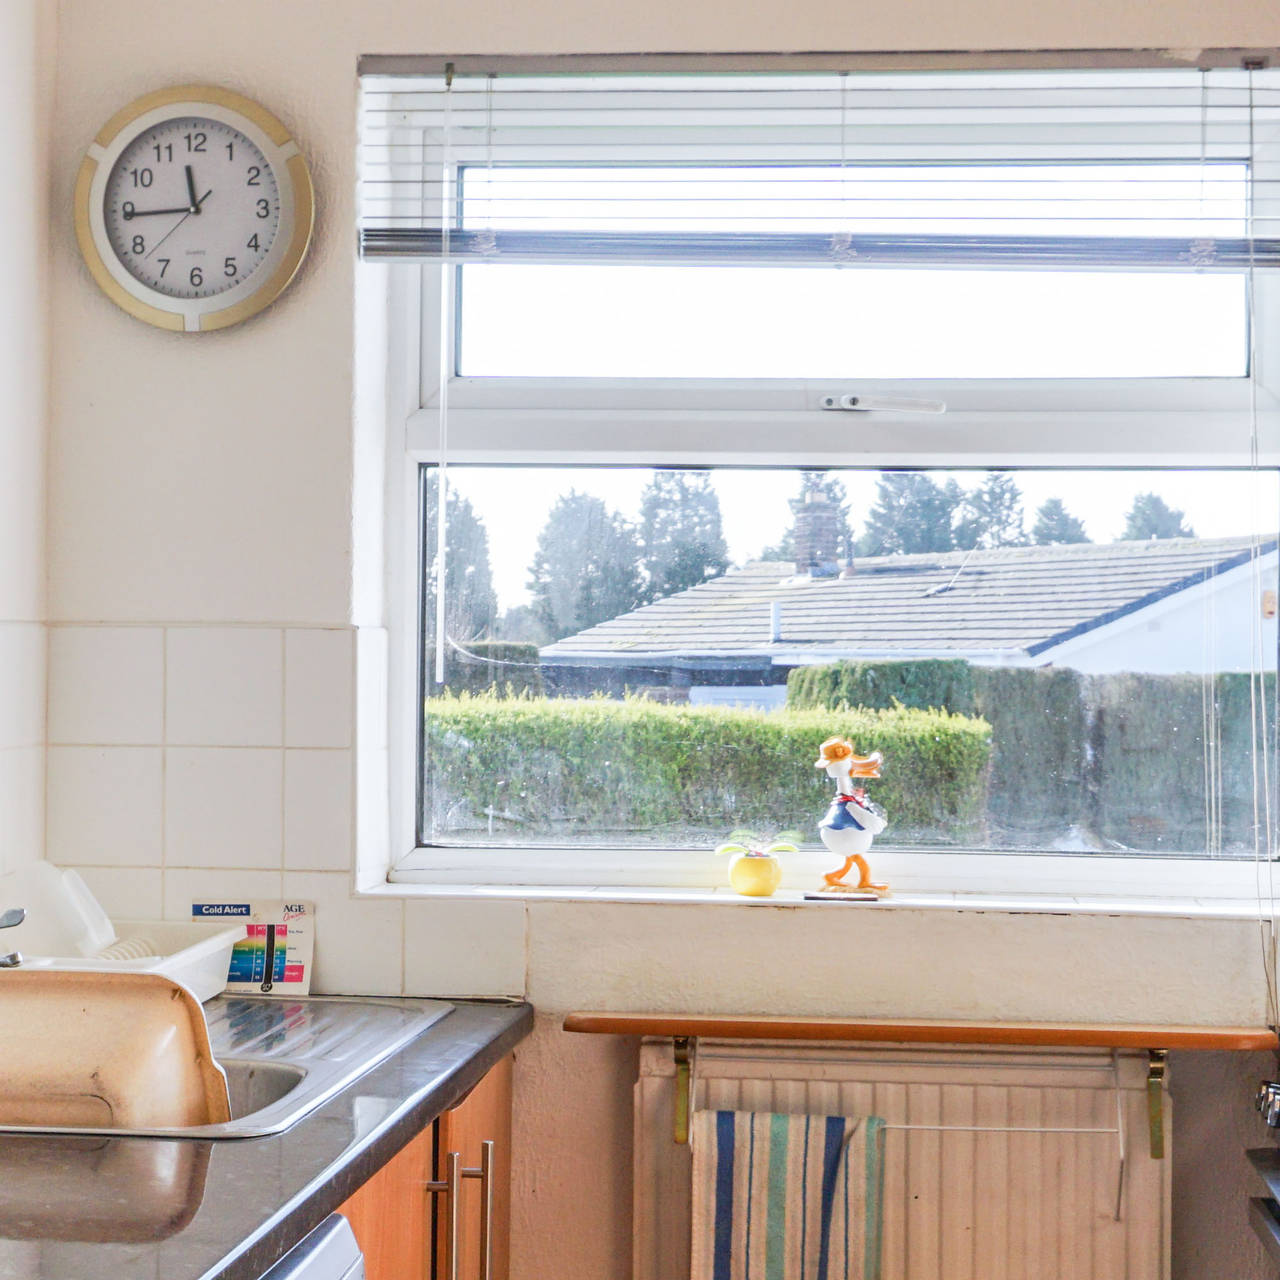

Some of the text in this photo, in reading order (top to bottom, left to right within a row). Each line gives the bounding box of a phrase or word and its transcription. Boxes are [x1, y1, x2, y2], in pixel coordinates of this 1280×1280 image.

[183, 133, 207, 152] 12
[225, 142, 234, 161] 1
[153, 144, 173, 162] 11
[130, 168, 153, 188] 10
[247, 166, 261, 186] 2
[122, 201, 135, 221] 9
[256, 199, 270, 219] 3
[132, 235, 145, 255] 8
[247, 233, 261, 252] 4
[157, 259, 171, 278] 7
[224, 257, 237, 277] 5
[190, 267, 203, 287] 6
[202, 905, 247, 914] Cold Alert
[283, 904, 306, 913] AGE
